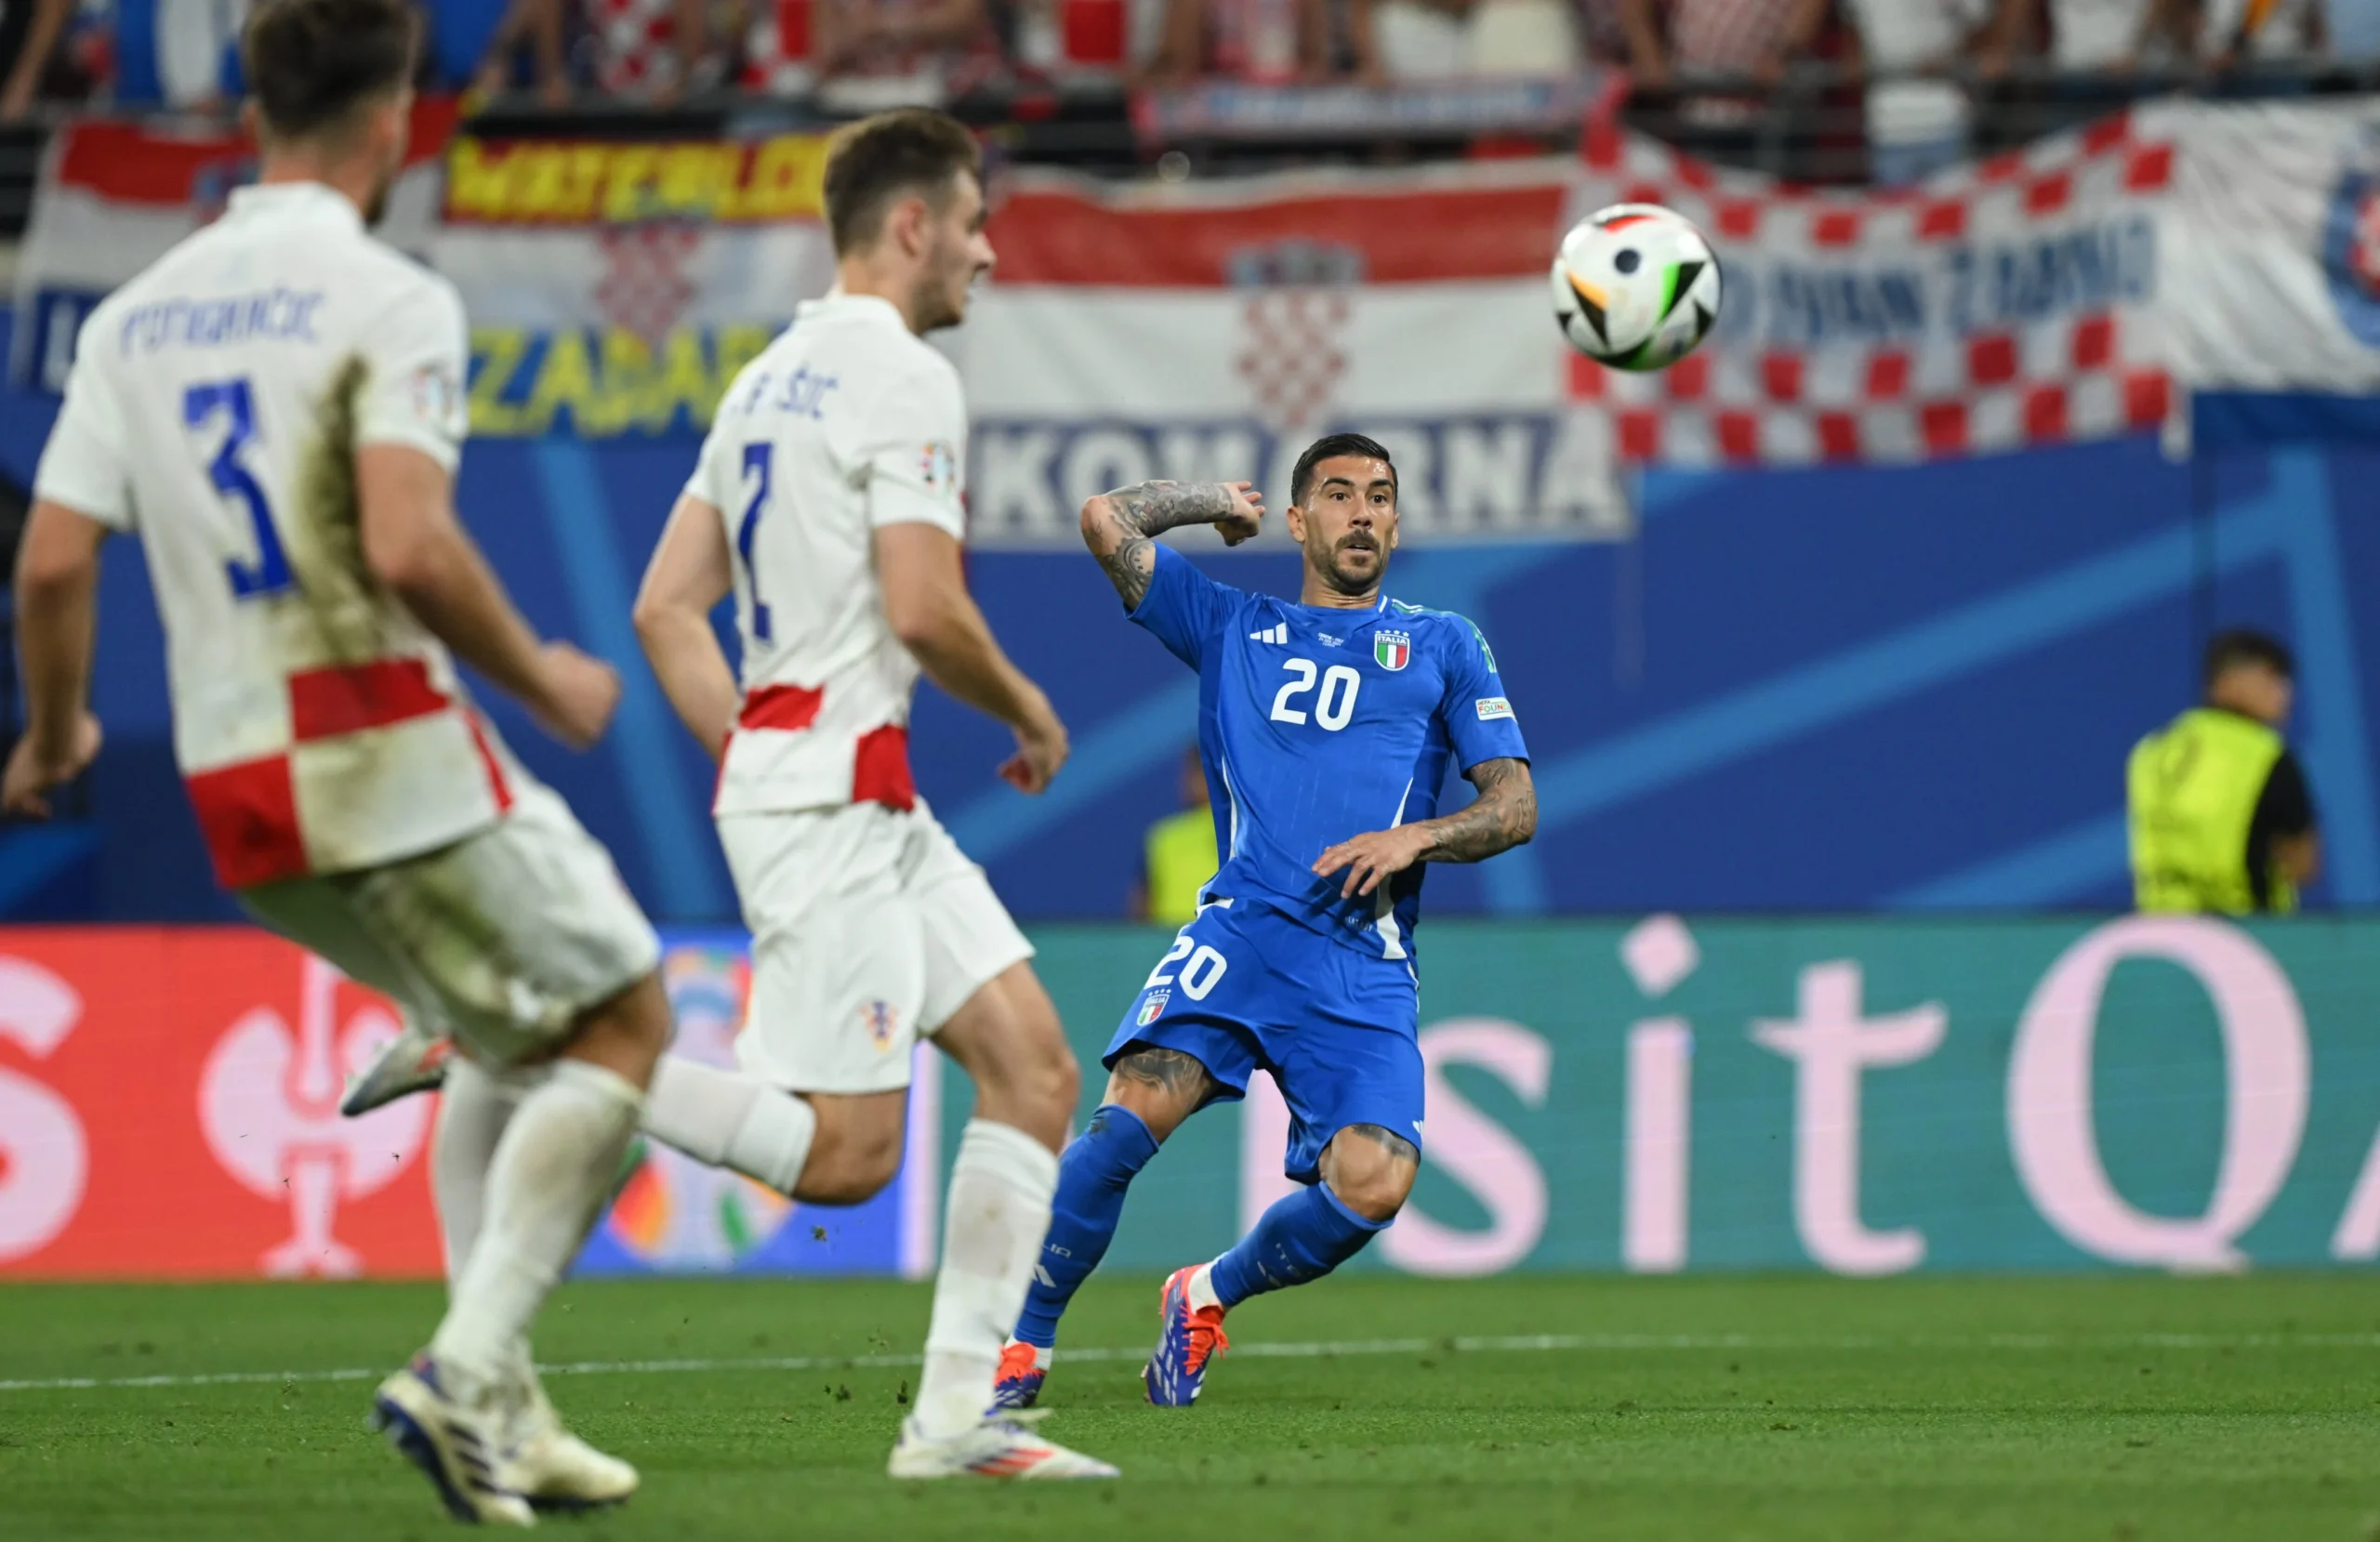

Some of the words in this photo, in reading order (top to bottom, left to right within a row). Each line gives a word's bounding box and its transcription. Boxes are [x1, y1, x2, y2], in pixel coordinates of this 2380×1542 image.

[444, 137, 831, 221] WATERLO
[182, 376, 294, 599] 3
[1377, 635, 1407, 645] ITALIA
[1270, 657, 1361, 731] 20
[1144, 935, 1227, 1001] 20
